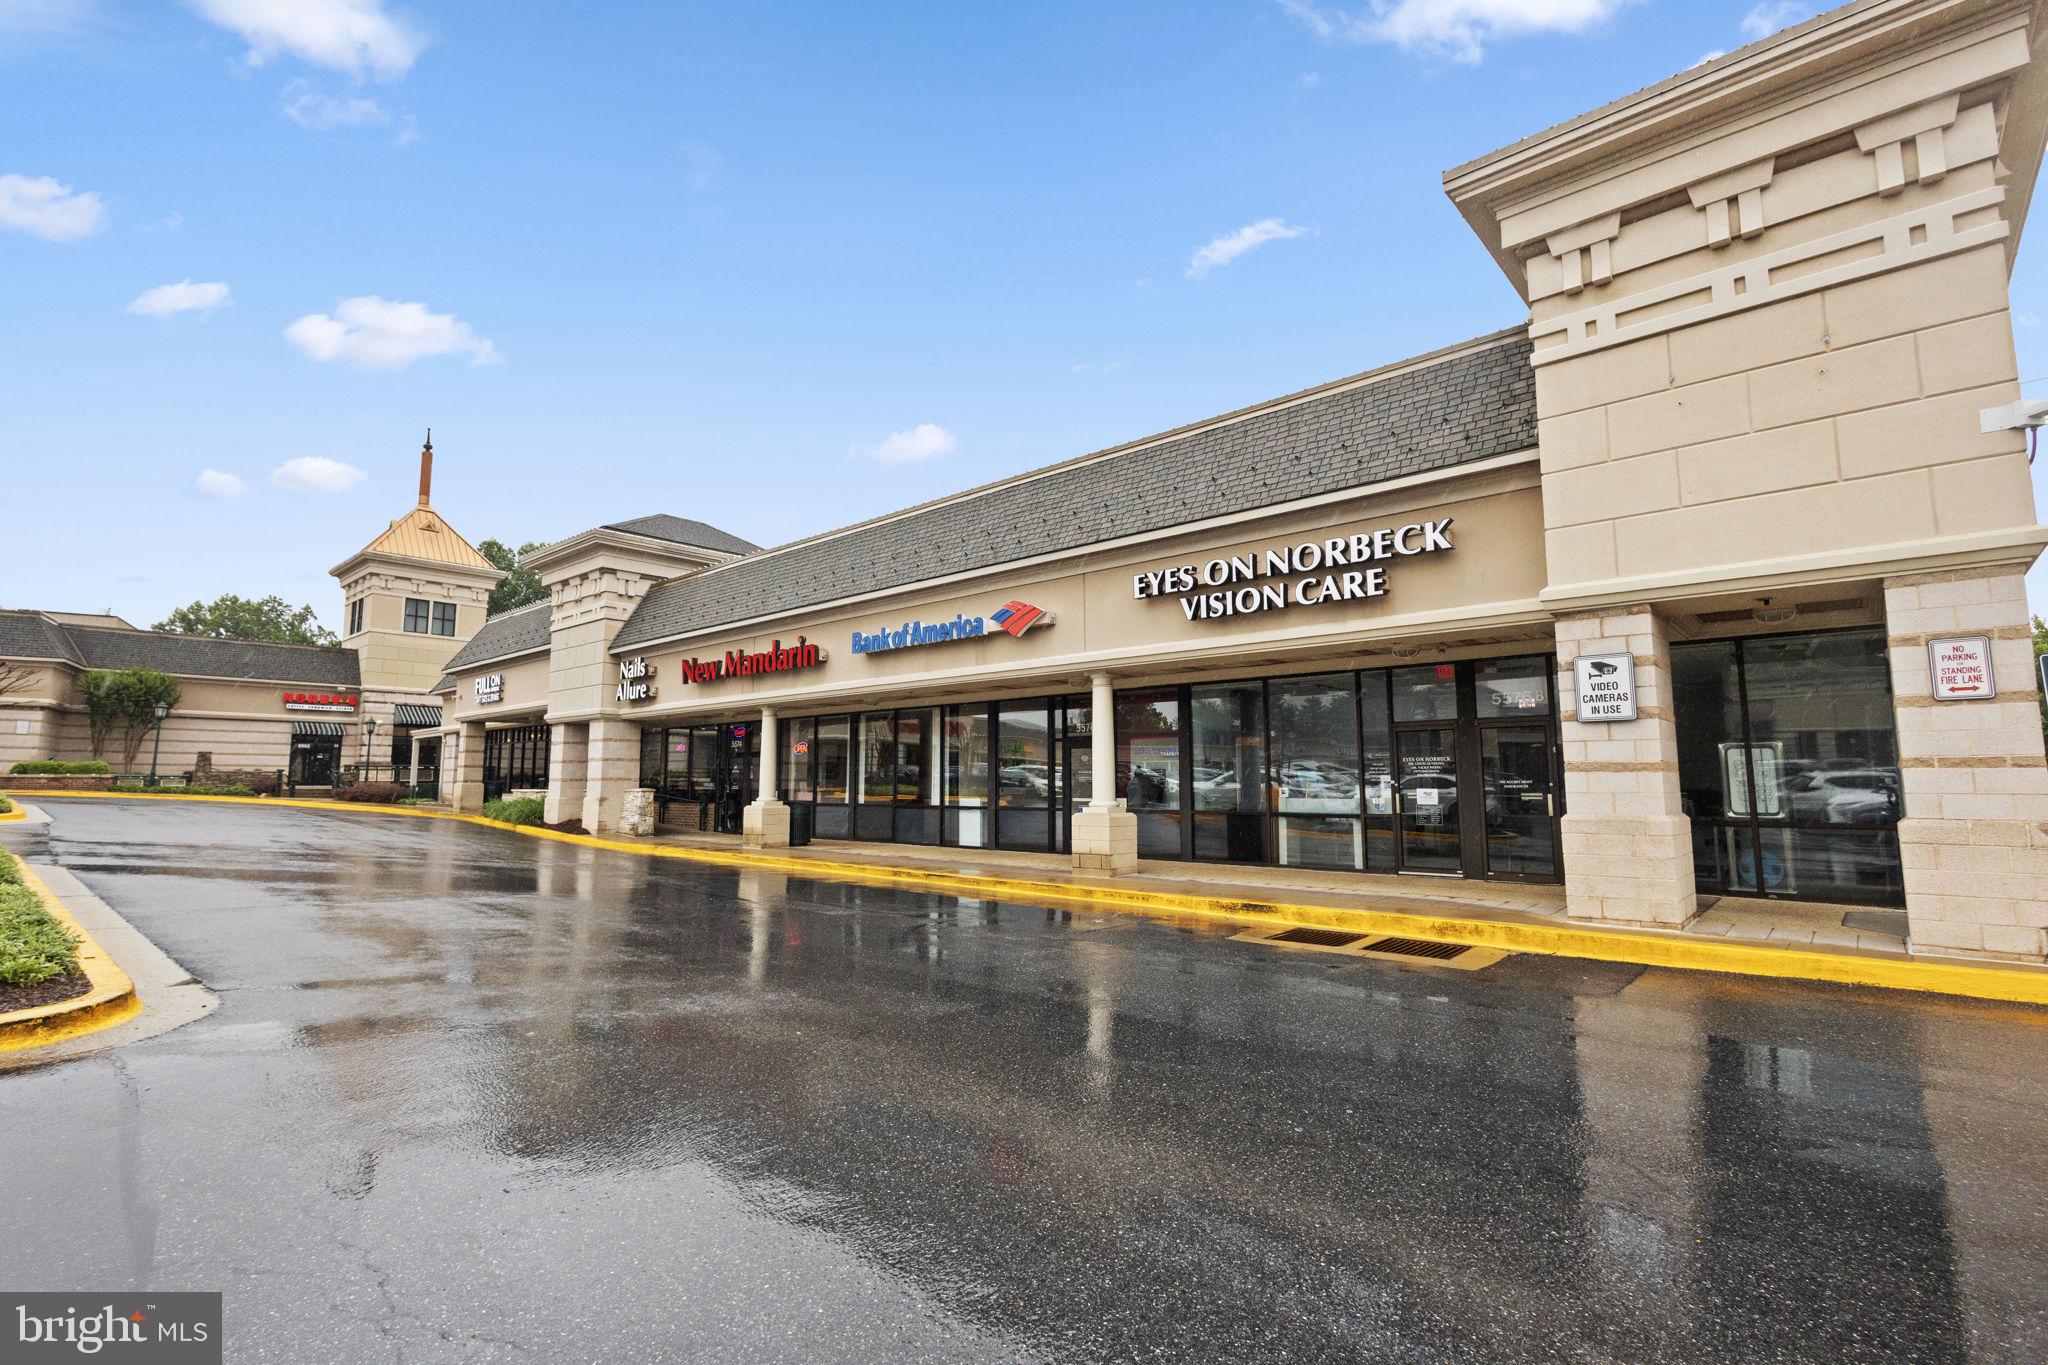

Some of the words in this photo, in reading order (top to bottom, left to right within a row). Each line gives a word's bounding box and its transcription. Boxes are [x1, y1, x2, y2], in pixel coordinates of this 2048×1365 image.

[1133, 565, 1195, 599] EYES
[1203, 552, 1254, 586] ON
[1266, 518, 1453, 577] NORBECK
[1180, 582, 1285, 620] VISION
[1295, 568, 1385, 605] CARE
[852, 627, 892, 654] Bank
[892, 622, 910, 649] of
[910, 614, 984, 645] America
[1952, 645, 1965, 653] NO
[681, 657, 722, 685] New
[723, 636, 818, 679] Mandarin
[1941, 652, 1978, 662] PARKING
[620, 657, 646, 680] Nails
[1941, 666, 1982, 675] STANDING
[474, 677, 491, 695] FULL
[491, 674, 501, 687] ON
[1590, 681, 1619, 691] VIDEO
[1940, 675, 1959, 685] FIRE
[1962, 674, 1985, 684] LANE
[616, 682, 647, 701] Allure
[1582, 692, 1629, 704] CAMERAS
[1591, 705, 1601, 715] IN
[1602, 704, 1622, 714] USE
